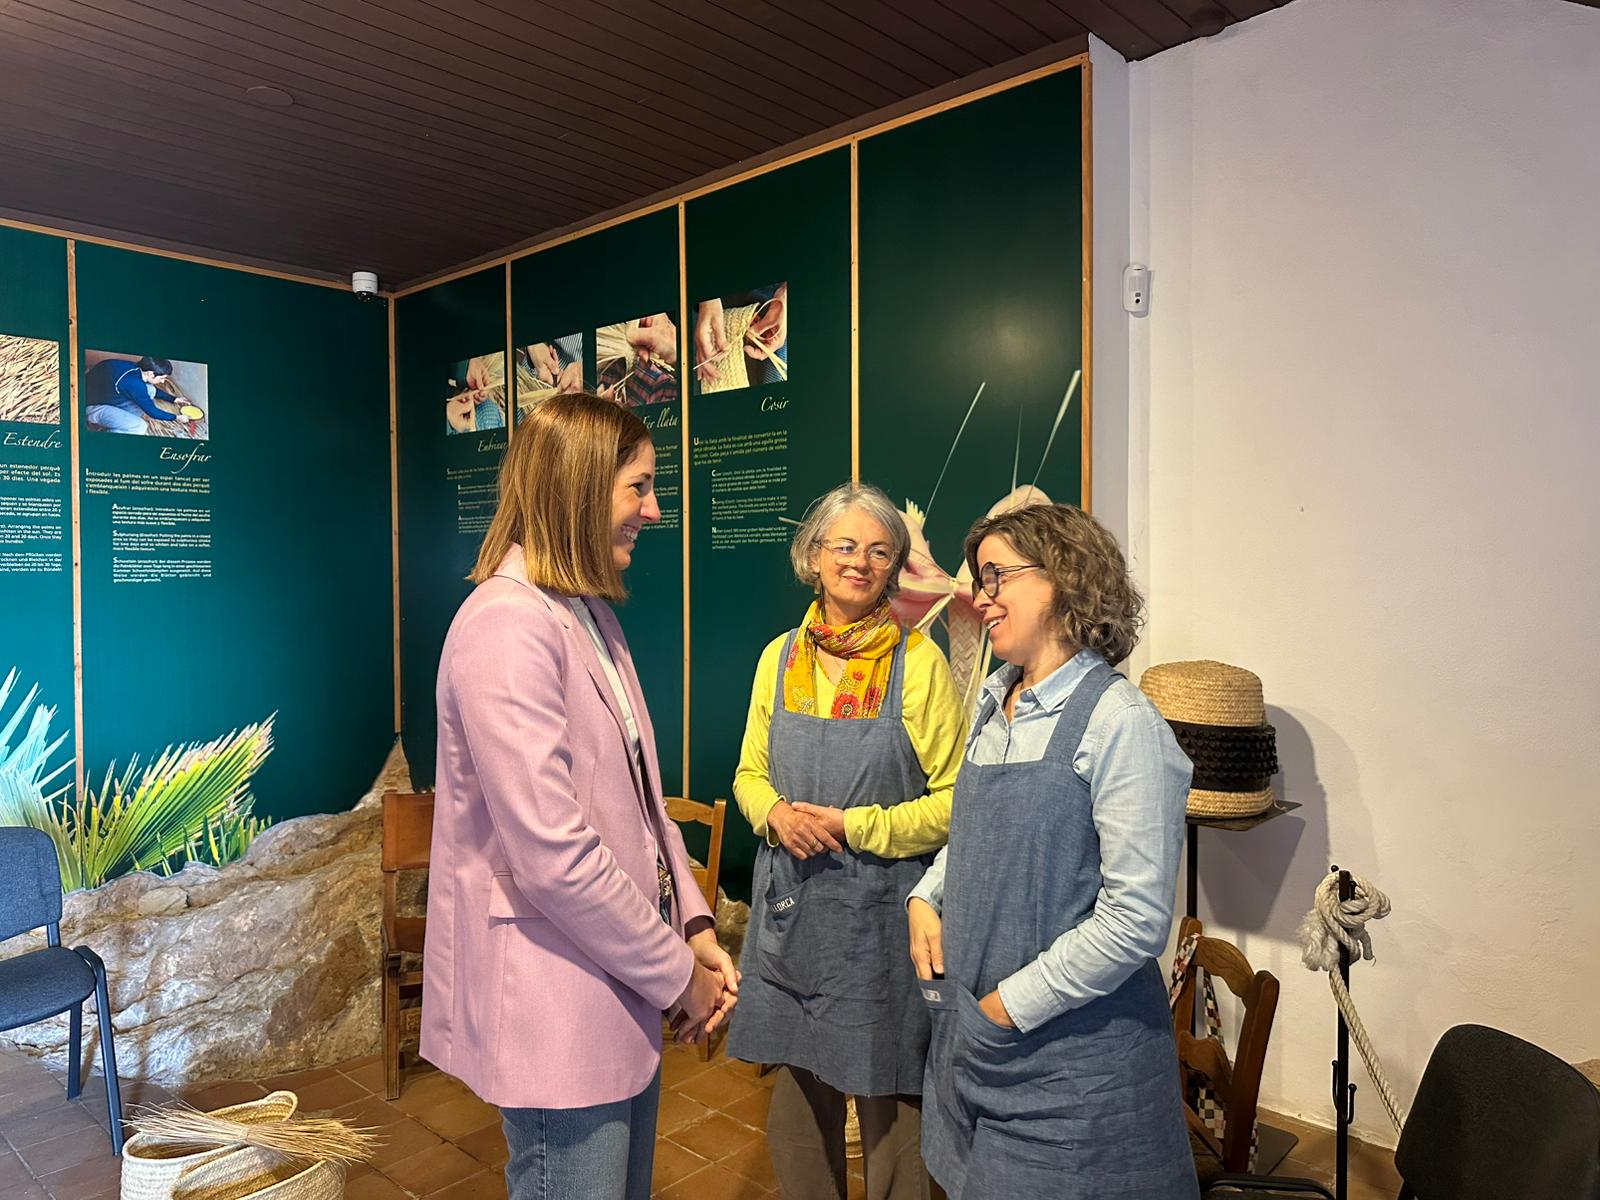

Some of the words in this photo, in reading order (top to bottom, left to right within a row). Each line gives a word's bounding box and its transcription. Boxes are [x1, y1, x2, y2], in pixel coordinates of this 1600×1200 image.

[761, 396, 790, 412] Cosir
[656, 407, 678, 428] llata
[4, 430, 62, 449] Estendre
[160, 443, 212, 474] Ensofrar
